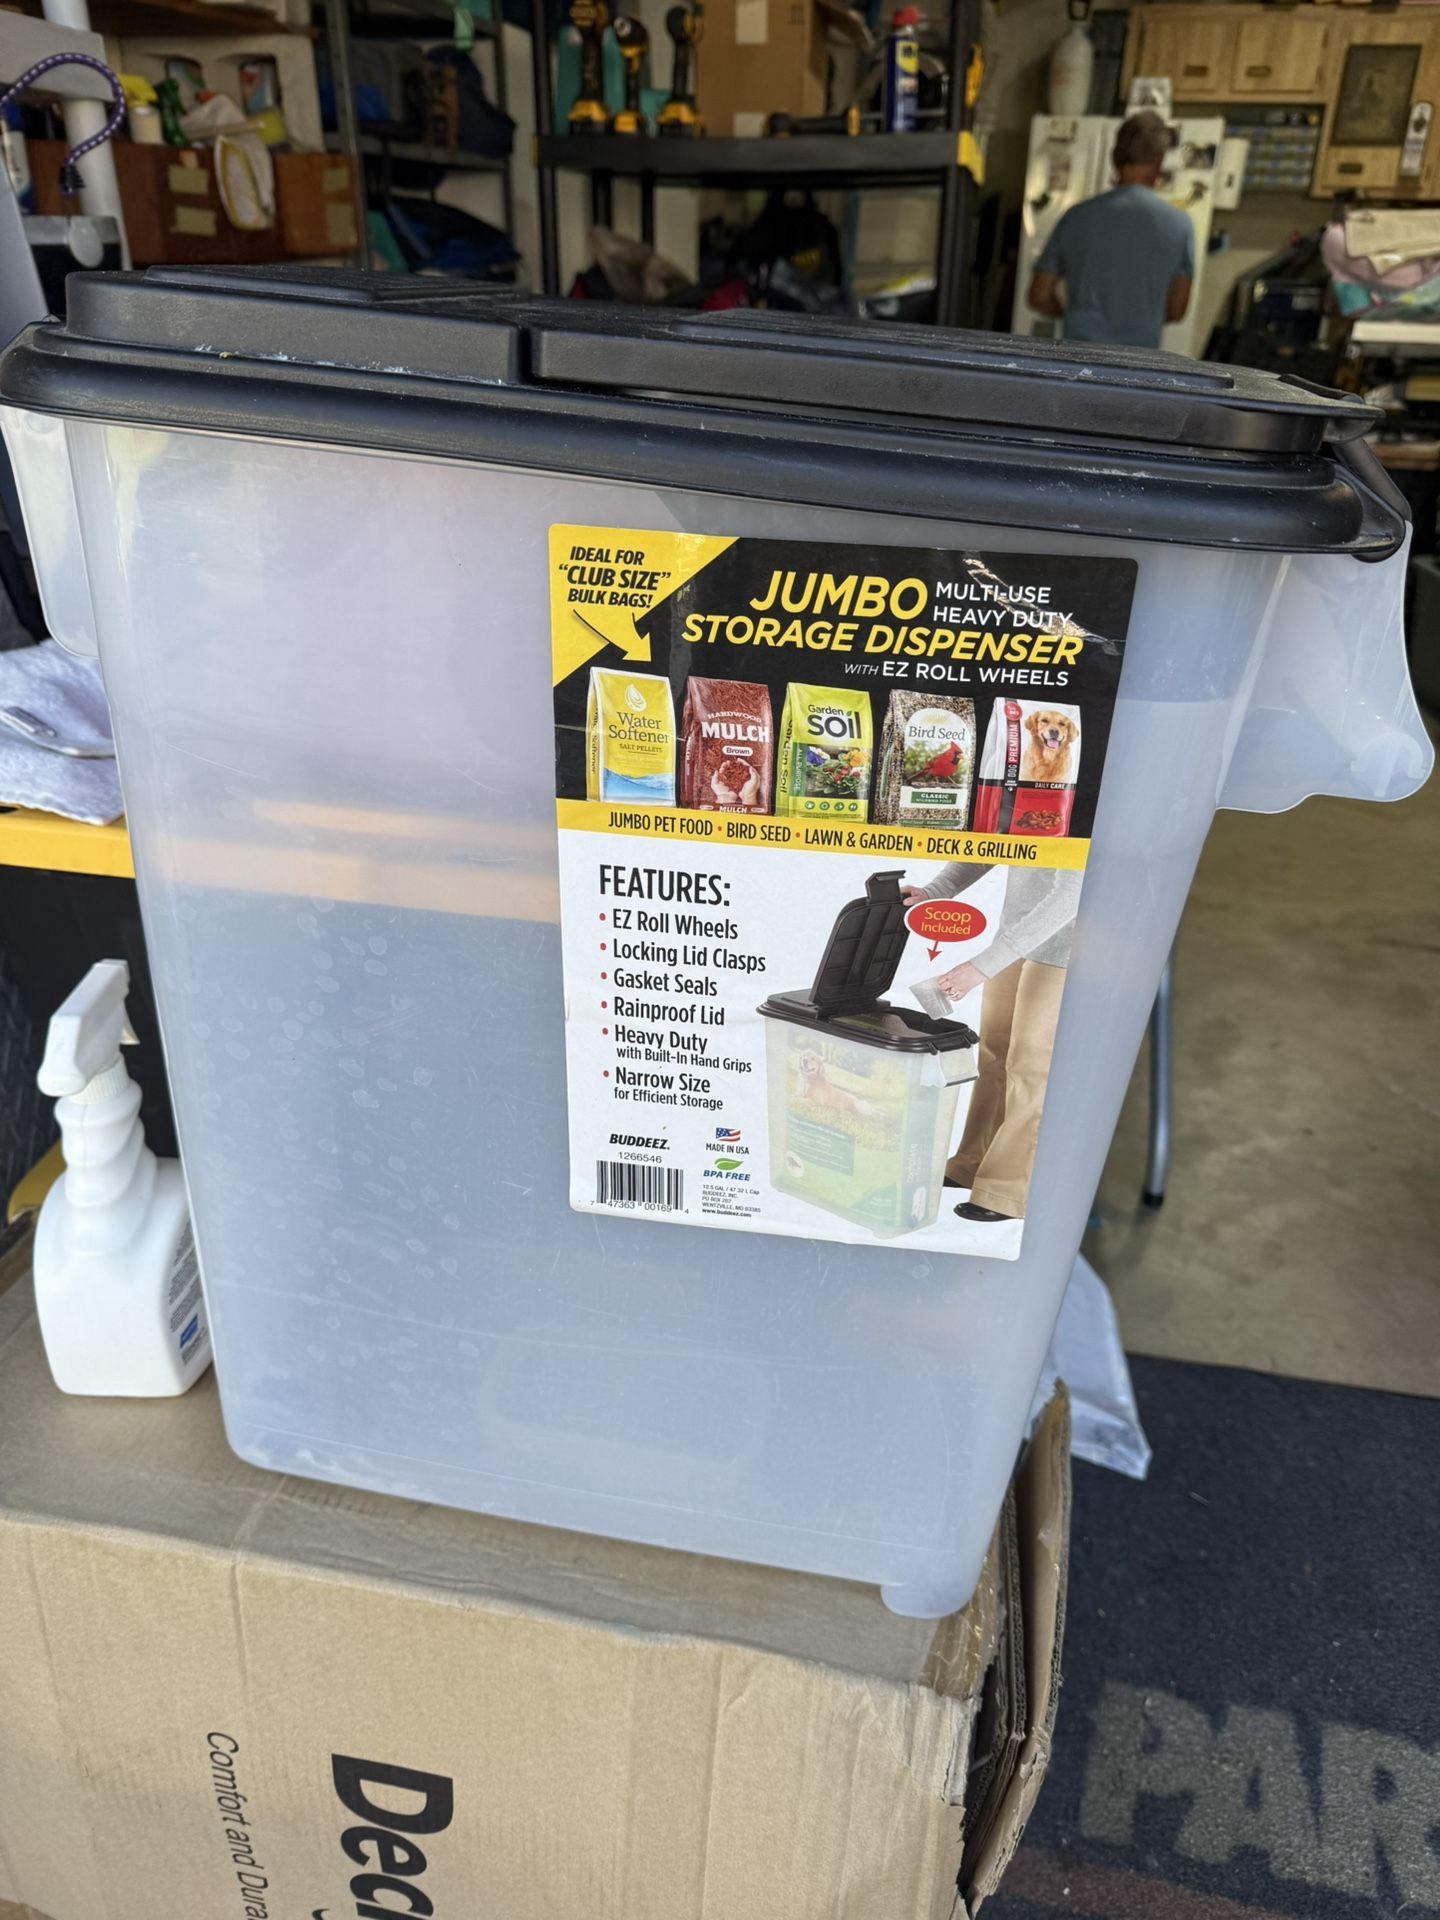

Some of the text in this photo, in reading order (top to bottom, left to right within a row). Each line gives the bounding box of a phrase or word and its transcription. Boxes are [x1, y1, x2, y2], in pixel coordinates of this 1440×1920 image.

[570, 546, 645, 566] IDEAL FOR
[559, 564, 671, 591] “CLUB SIZE”
[568, 588, 653, 608] BULK BAGS!
[749, 570, 928, 620] JUMBO
[935, 581, 1051, 604] MULTI-USE
[933, 605, 1073, 628] HEAVY DUTY
[681, 613, 1084, 666] STORAGE DISPENSER
[844, 661, 1069, 687] WITH EZ ROLL WHEELS
[617, 711, 662, 730] Water
[707, 711, 763, 723] HARDWOOD
[808, 704, 844, 716] Garden
[608, 725, 669, 744] Softener
[701, 721, 770, 743] MULCH
[908, 725, 966, 741] Bird Seed
[1008, 724, 1019, 763] PREMIUM
[619, 743, 635, 751] SALT
[726, 746, 750, 755] Brown
[1008, 764, 1018, 778] DOG
[608, 812, 1037, 861] JUMBO PET FOOD BIRD SEED LAWN & GARDEN DECK & GRILLING
[599, 864, 731, 907] FEATURES:
[613, 908, 738, 940] EZ Roll Wheels
[924, 907, 971, 925] Scoop
[921, 922, 971, 935] Included
[613, 938, 766, 974] Locking Lid Clasps
[614, 968, 718, 997] Gasket Seals
[614, 996, 725, 1026] Rainproof Lid
[615, 1024, 708, 1055] Heavy Duty
[616, 1047, 752, 1074] with Built-In Hand Grips
[615, 1066, 710, 1094] Narrow Size
[614, 1087, 723, 1111] for Efficient Storage
[619, 1151, 662, 1163] 1266546
[706, 1143, 750, 1155] MADE IN USA
[703, 1169, 751, 1181] BPA FREE
[607, 1200, 635, 1209] 47363
[644, 1203, 672, 1212] 00169
[1079, 1681, 1440, 1910] PAR
[207, 1732, 268, 1920] Comfort and Dura
